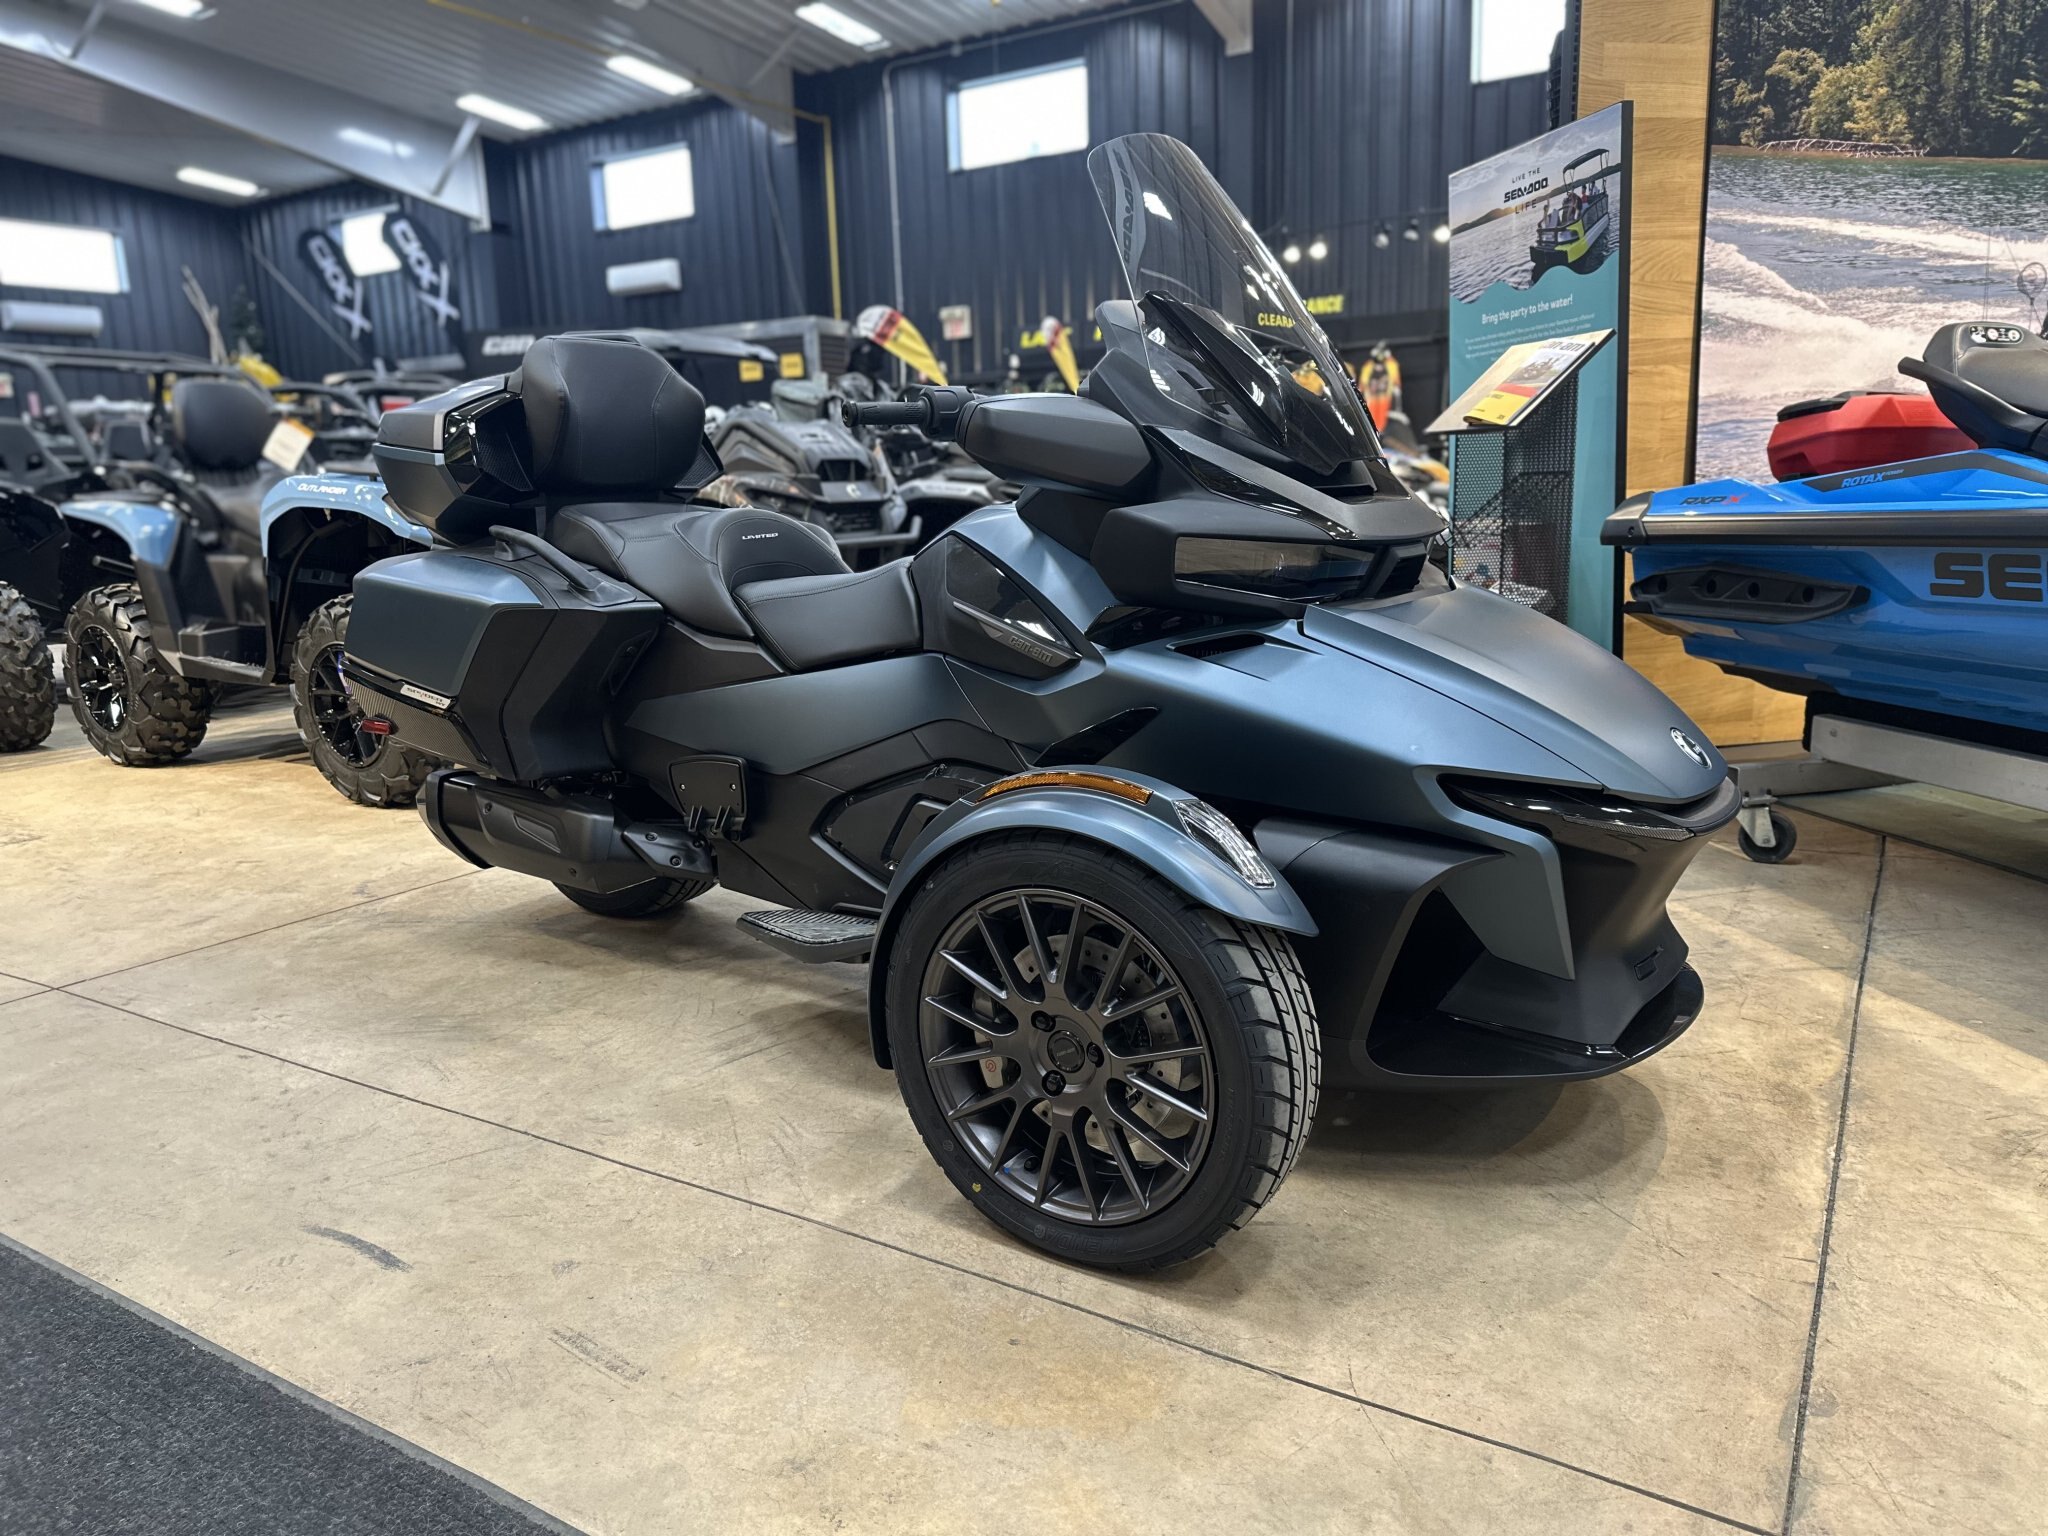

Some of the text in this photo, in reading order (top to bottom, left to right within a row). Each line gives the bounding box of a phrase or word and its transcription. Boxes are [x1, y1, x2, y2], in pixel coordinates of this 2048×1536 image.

[1511, 167, 1541, 184] LIVE THE
[1515, 199, 1537, 214] LIFE
[1481, 293, 1573, 325] Bring the party to the water!
[1841, 472, 1885, 488] ROTAX
[297, 482, 348, 495] OUTLANDER
[741, 532, 779, 540] LIMITED
[1929, 552, 2048, 602] SE
